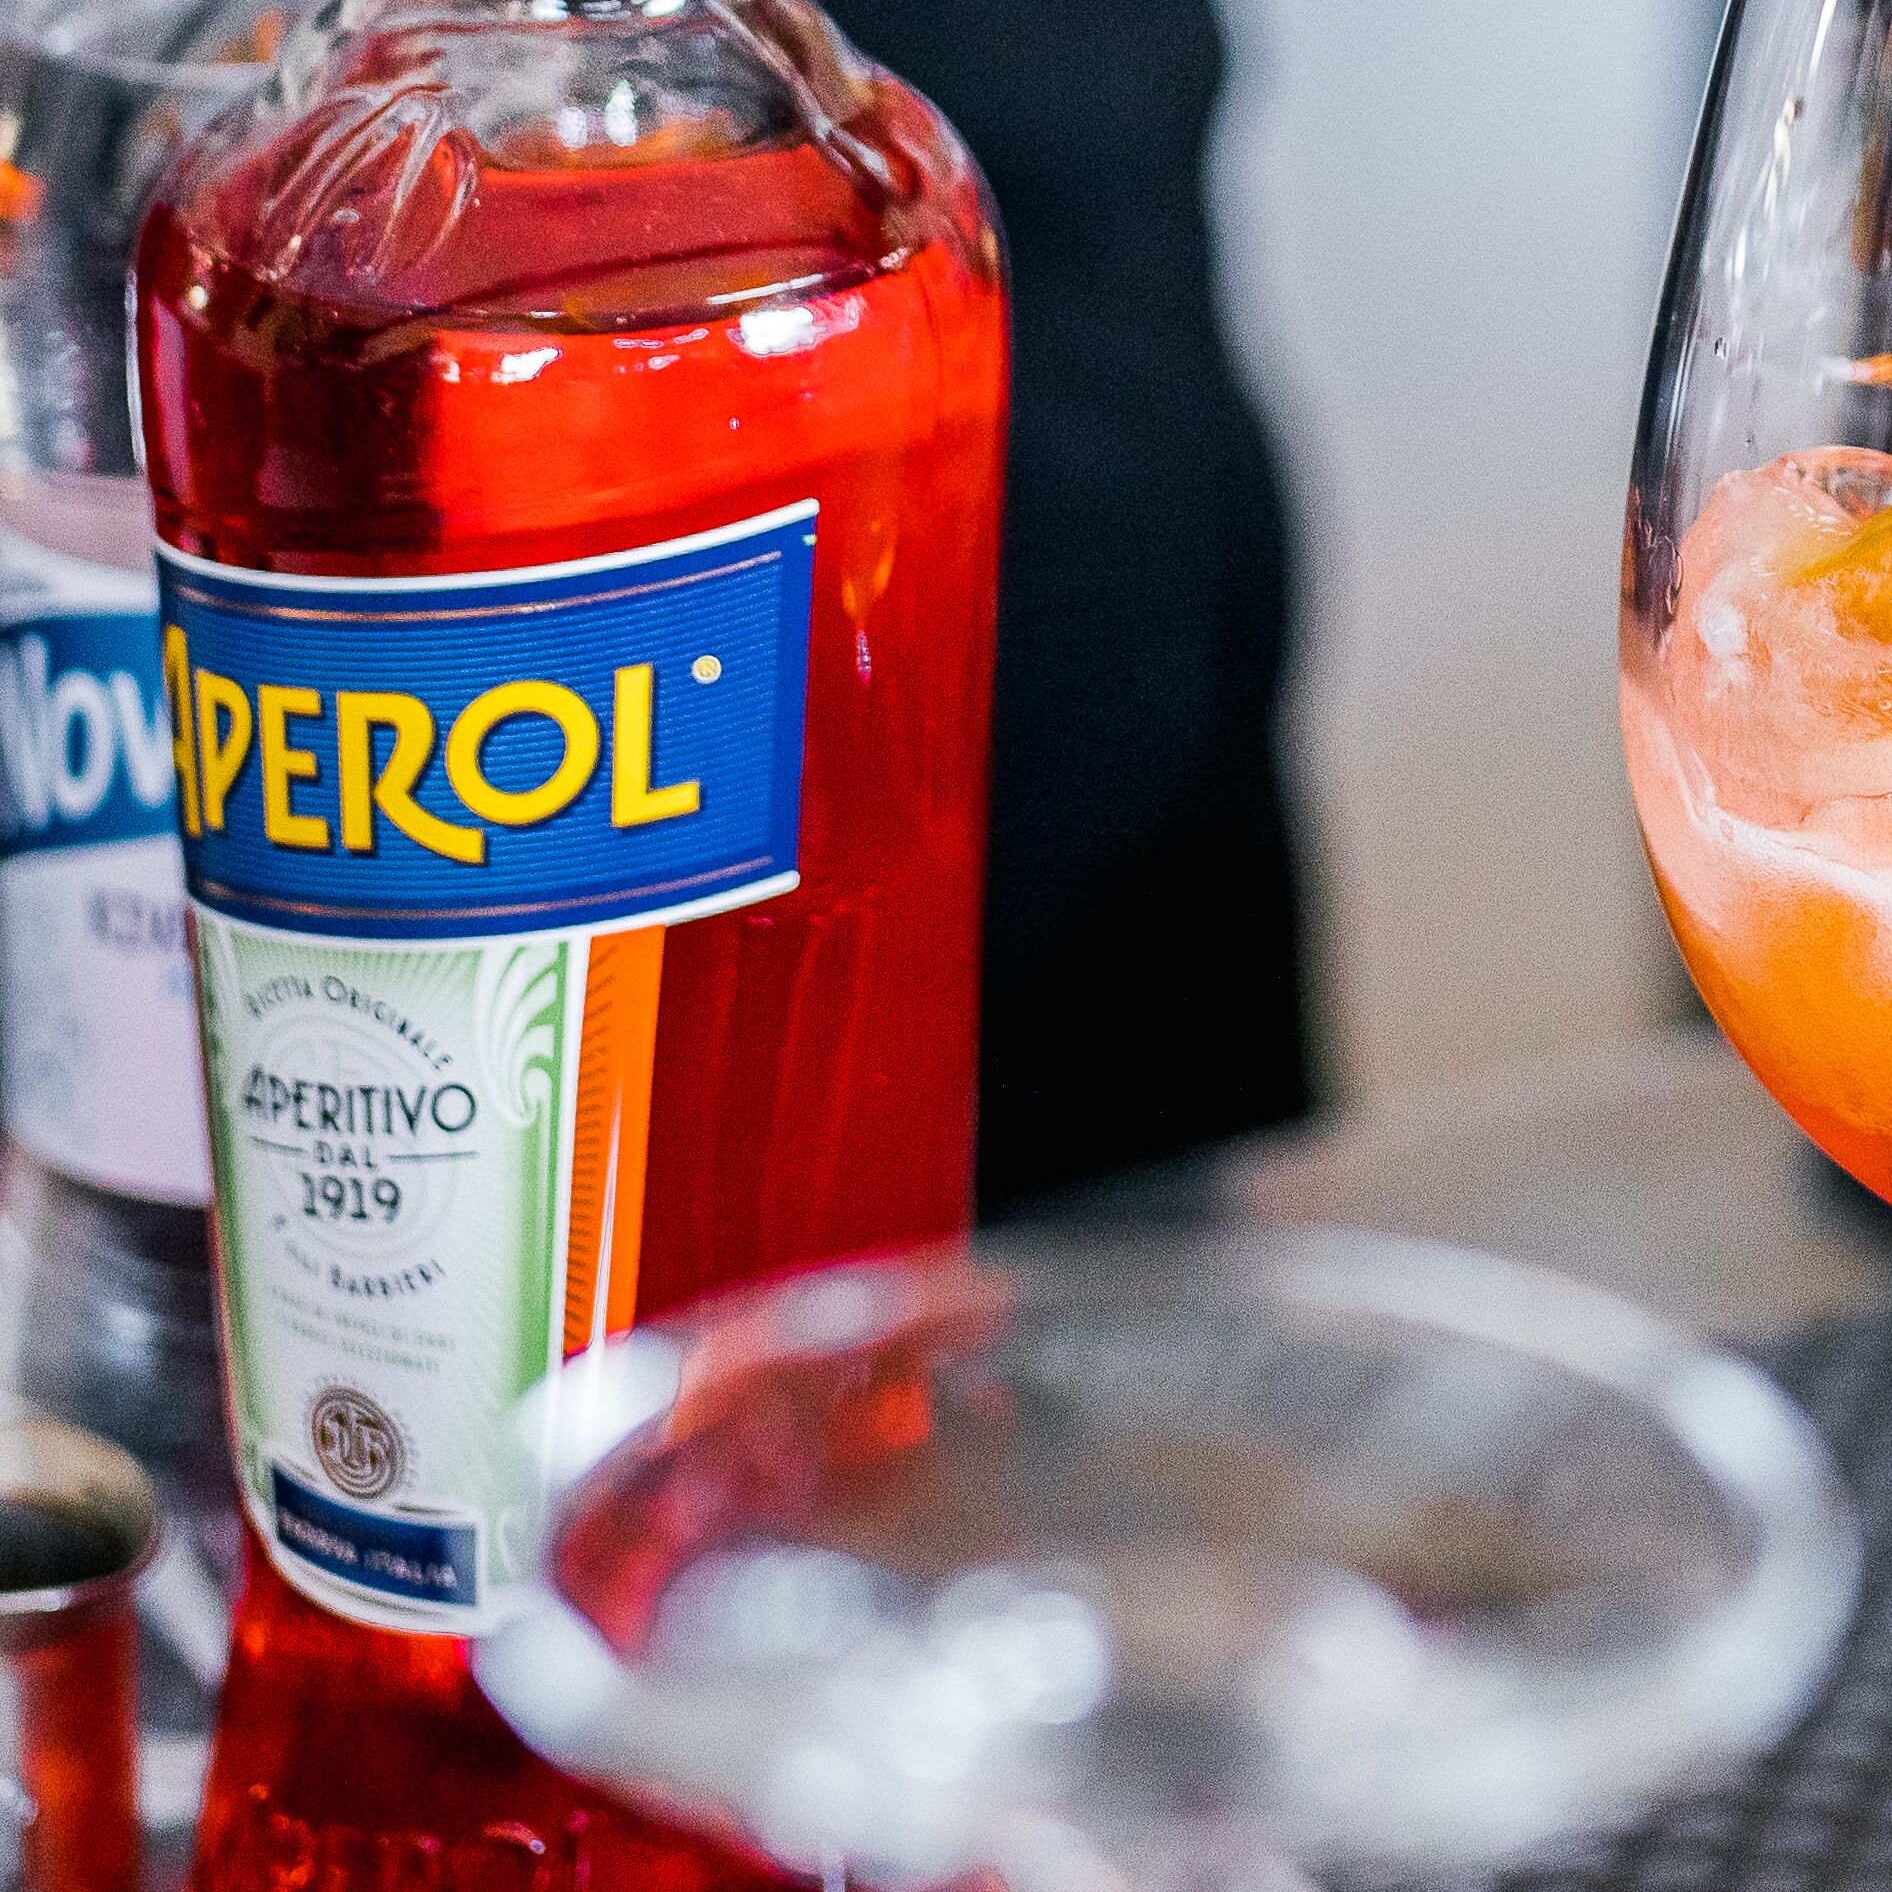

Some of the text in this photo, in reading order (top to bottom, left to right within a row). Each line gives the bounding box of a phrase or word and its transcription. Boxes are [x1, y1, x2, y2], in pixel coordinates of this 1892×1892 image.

[244, 1065, 477, 1136] APERITIVO
[313, 1139, 378, 1172] DAL
[301, 1170, 402, 1224] 1919
